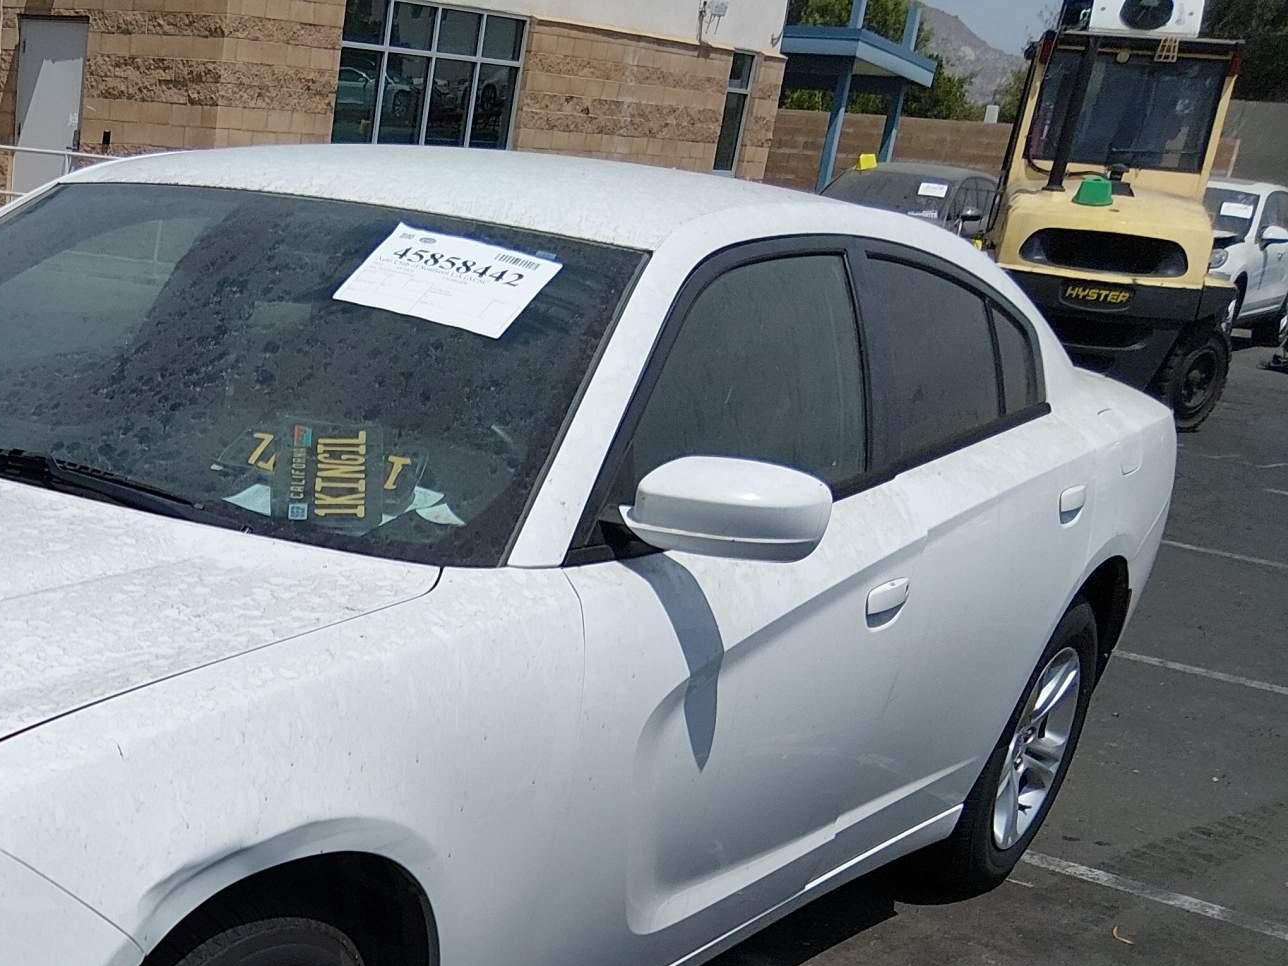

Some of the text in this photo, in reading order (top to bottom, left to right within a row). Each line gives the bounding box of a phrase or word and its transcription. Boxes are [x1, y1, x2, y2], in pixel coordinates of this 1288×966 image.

[393, 247, 524, 286] 45858442
[1064, 286, 1129, 303] HYSTER
[314, 430, 366, 518] 1KINGIL
